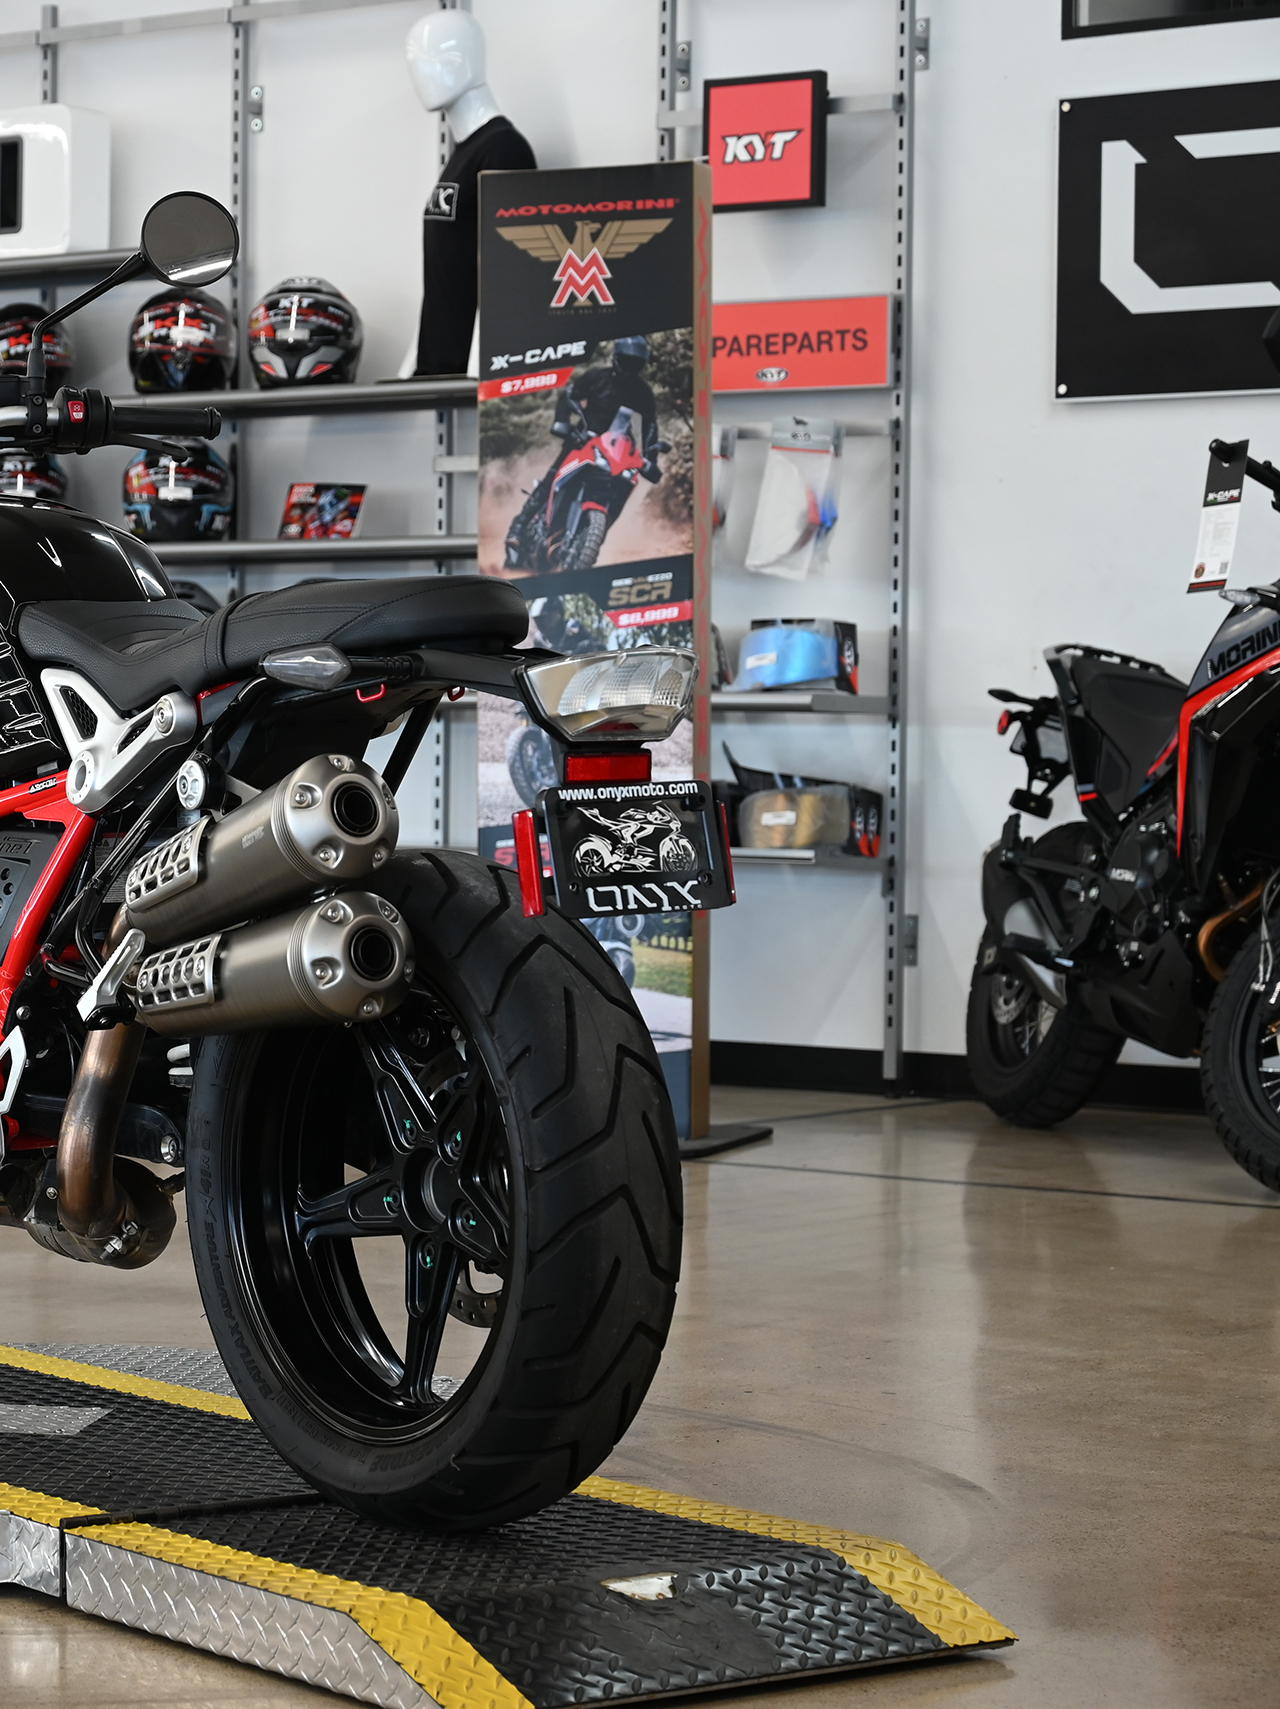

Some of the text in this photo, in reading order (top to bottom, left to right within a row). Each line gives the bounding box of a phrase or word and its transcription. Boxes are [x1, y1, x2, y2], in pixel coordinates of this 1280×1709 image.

[722, 129, 801, 164] KYT
[490, 341, 587, 371] X-CAPE
[712, 328, 868, 357] PAREPARTS
[1208, 618, 1280, 677] MORIN
[558, 782, 698, 801] www.onyxmoto.com
[586, 881, 702, 912] ONYX
[204, 1221, 236, 1322] ADVENTURE
[228, 1323, 274, 1400] BATTLAX
